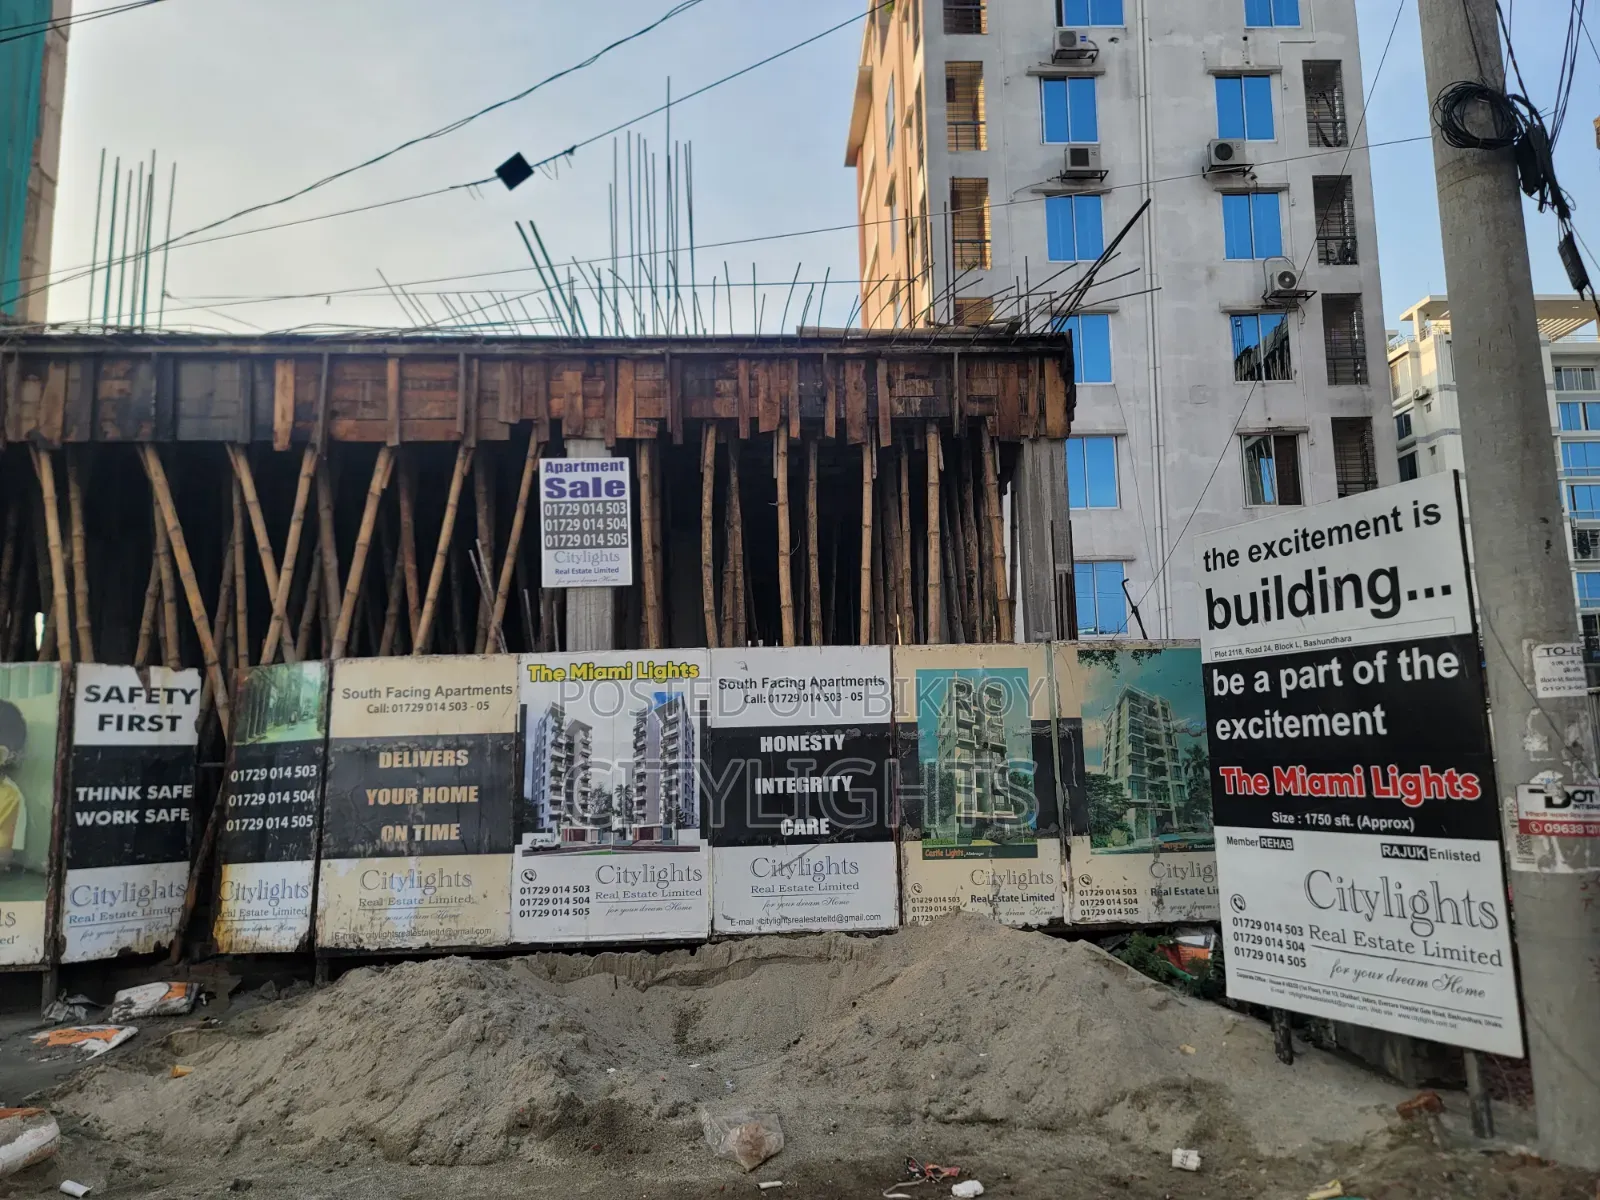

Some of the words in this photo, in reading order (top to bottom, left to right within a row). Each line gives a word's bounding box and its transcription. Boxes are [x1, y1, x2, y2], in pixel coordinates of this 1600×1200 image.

[545, 461, 624, 474] Apartment
[545, 477, 625, 498] Sale
[545, 504, 580, 516] 01729
[582, 503, 603, 514] 014
[606, 502, 626, 514] 503
[545, 519, 580, 531] 01729
[583, 519, 604, 530] 014
[606, 518, 627, 530] 504
[546, 535, 580, 547] 01729
[584, 534, 604, 546] 014
[607, 534, 627, 545] 505
[1203, 548, 1240, 572] the
[1248, 506, 1403, 563] excitement
[1413, 500, 1441, 528] is
[554, 550, 620, 566] Citylights
[1275, 642, 1293, 650] Block
[1304, 636, 1352, 646] Bashundhara
[527, 664, 566, 682] The
[570, 661, 632, 681] Miami
[637, 661, 700, 683] Lights
[1212, 668, 1244, 695] be
[1254, 671, 1270, 693] a
[1280, 657, 1342, 698] part
[1353, 651, 1388, 685] of
[1398, 648, 1459, 682] the
[718, 678, 757, 690] South
[762, 677, 806, 690] Facing
[810, 675, 885, 689] Apartments
[84, 684, 199, 705] SAFETY
[343, 688, 381, 699] South
[387, 686, 431, 700] Facing
[434, 684, 512, 699] Apartments
[744, 694, 766, 704] Call:
[768, 693, 799, 703] 01729
[803, 694, 821, 702] 014
[824, 693, 841, 702] 503
[851, 692, 862, 701] 05
[367, 704, 389, 714] Call:
[392, 703, 423, 713] 01729
[426, 703, 445, 711] 014
[449, 703, 467, 711] 503
[477, 702, 489, 710] 05
[98, 714, 182, 732] FIRST
[1216, 704, 1387, 740] excitement
[760, 734, 845, 752] HONESTY
[379, 749, 468, 768] DELIVERS
[231, 768, 267, 782] 01729
[270, 767, 292, 779] 014
[294, 765, 317, 777] 503
[76, 786, 141, 801] THINK
[147, 785, 193, 799] SAFE
[755, 776, 853, 794] INTEGRITY
[1219, 766, 1269, 796] The
[1274, 764, 1365, 797] Miami
[1372, 764, 1481, 807] Lights
[229, 793, 265, 807] 01729
[268, 791, 290, 804] 014
[293, 790, 315, 803] 504
[366, 787, 418, 806] YOUR
[423, 785, 479, 804] HOME
[75, 810, 139, 826] WORK
[145, 808, 189, 823] SAFE
[226, 818, 263, 832] 01729
[266, 816, 288, 829] 014
[291, 815, 313, 827] 505
[1272, 811, 1294, 825] Size
[1305, 813, 1331, 826] 1750
[1334, 815, 1354, 827] sft.
[1357, 815, 1414, 832] (Approx)
[381, 825, 407, 842] ON
[412, 823, 460, 841] TIME
[780, 818, 830, 836] CARE
[1227, 836, 1258, 848] Member
[1260, 837, 1293, 849] REHAB
[1381, 844, 1427, 859] RAJUK
[1430, 848, 1480, 862] Enlisted
[595, 863, 702, 889] Citylights
[751, 856, 859, 882] Citylights
[360, 868, 472, 895] Citylights
[520, 886, 550, 894] 01729
[553, 885, 570, 894] 014
[573, 885, 590, 893] 503
[751, 885, 774, 894] Real
[779, 884, 814, 892] Estate
[818, 882, 859, 891] Limited
[70, 880, 186, 907] Citylights
[220, 879, 309, 906] Citylights
[595, 891, 619, 899] Real
[623, 890, 658, 899] Estate
[661, 889, 702, 897] Limited
[971, 895, 990, 903] Real
[992, 894, 1019, 902] Estate
[1022, 893, 1055, 901] Limited
[1151, 887, 1171, 896] Real
[1174, 887, 1205, 895] Estate
[359, 898, 383, 907] Real
[387, 897, 424, 906] Estate
[428, 895, 472, 904] Limited
[520, 898, 549, 906] 01729
[552, 897, 569, 905] 014
[573, 897, 590, 905] 504
[606, 906, 618, 916] for
[621, 906, 638, 914] your
[665, 902, 692, 910] Home
[1080, 898, 1104, 906] 01729
[1304, 869, 1498, 937] Citylights
[70, 914, 95, 924] Real
[100, 911, 137, 920] Estate
[240, 909, 269, 917] Estate
[273, 906, 307, 915] Limited
[520, 909, 549, 918] 01729
[552, 909, 570, 917] 014
[573, 908, 590, 916] 505
[1233, 917, 1262, 930] 01729
[1264, 922, 1282, 932] 014
[1285, 925, 1303, 936] 503
[1233, 932, 1263, 945] 01729
[1265, 936, 1283, 948] 014
[1285, 939, 1305, 951] 504
[1309, 924, 1346, 944] Real
[1354, 934, 1415, 954] Estate
[1422, 940, 1503, 966] Limited
[1234, 946, 1263, 960] 01729
[1265, 951, 1284, 963] 014
[1287, 954, 1306, 967] 505
[1329, 959, 1350, 978] for
[1354, 965, 1384, 983] your
[1387, 968, 1428, 989] dream
[1432, 973, 1485, 998] Home
